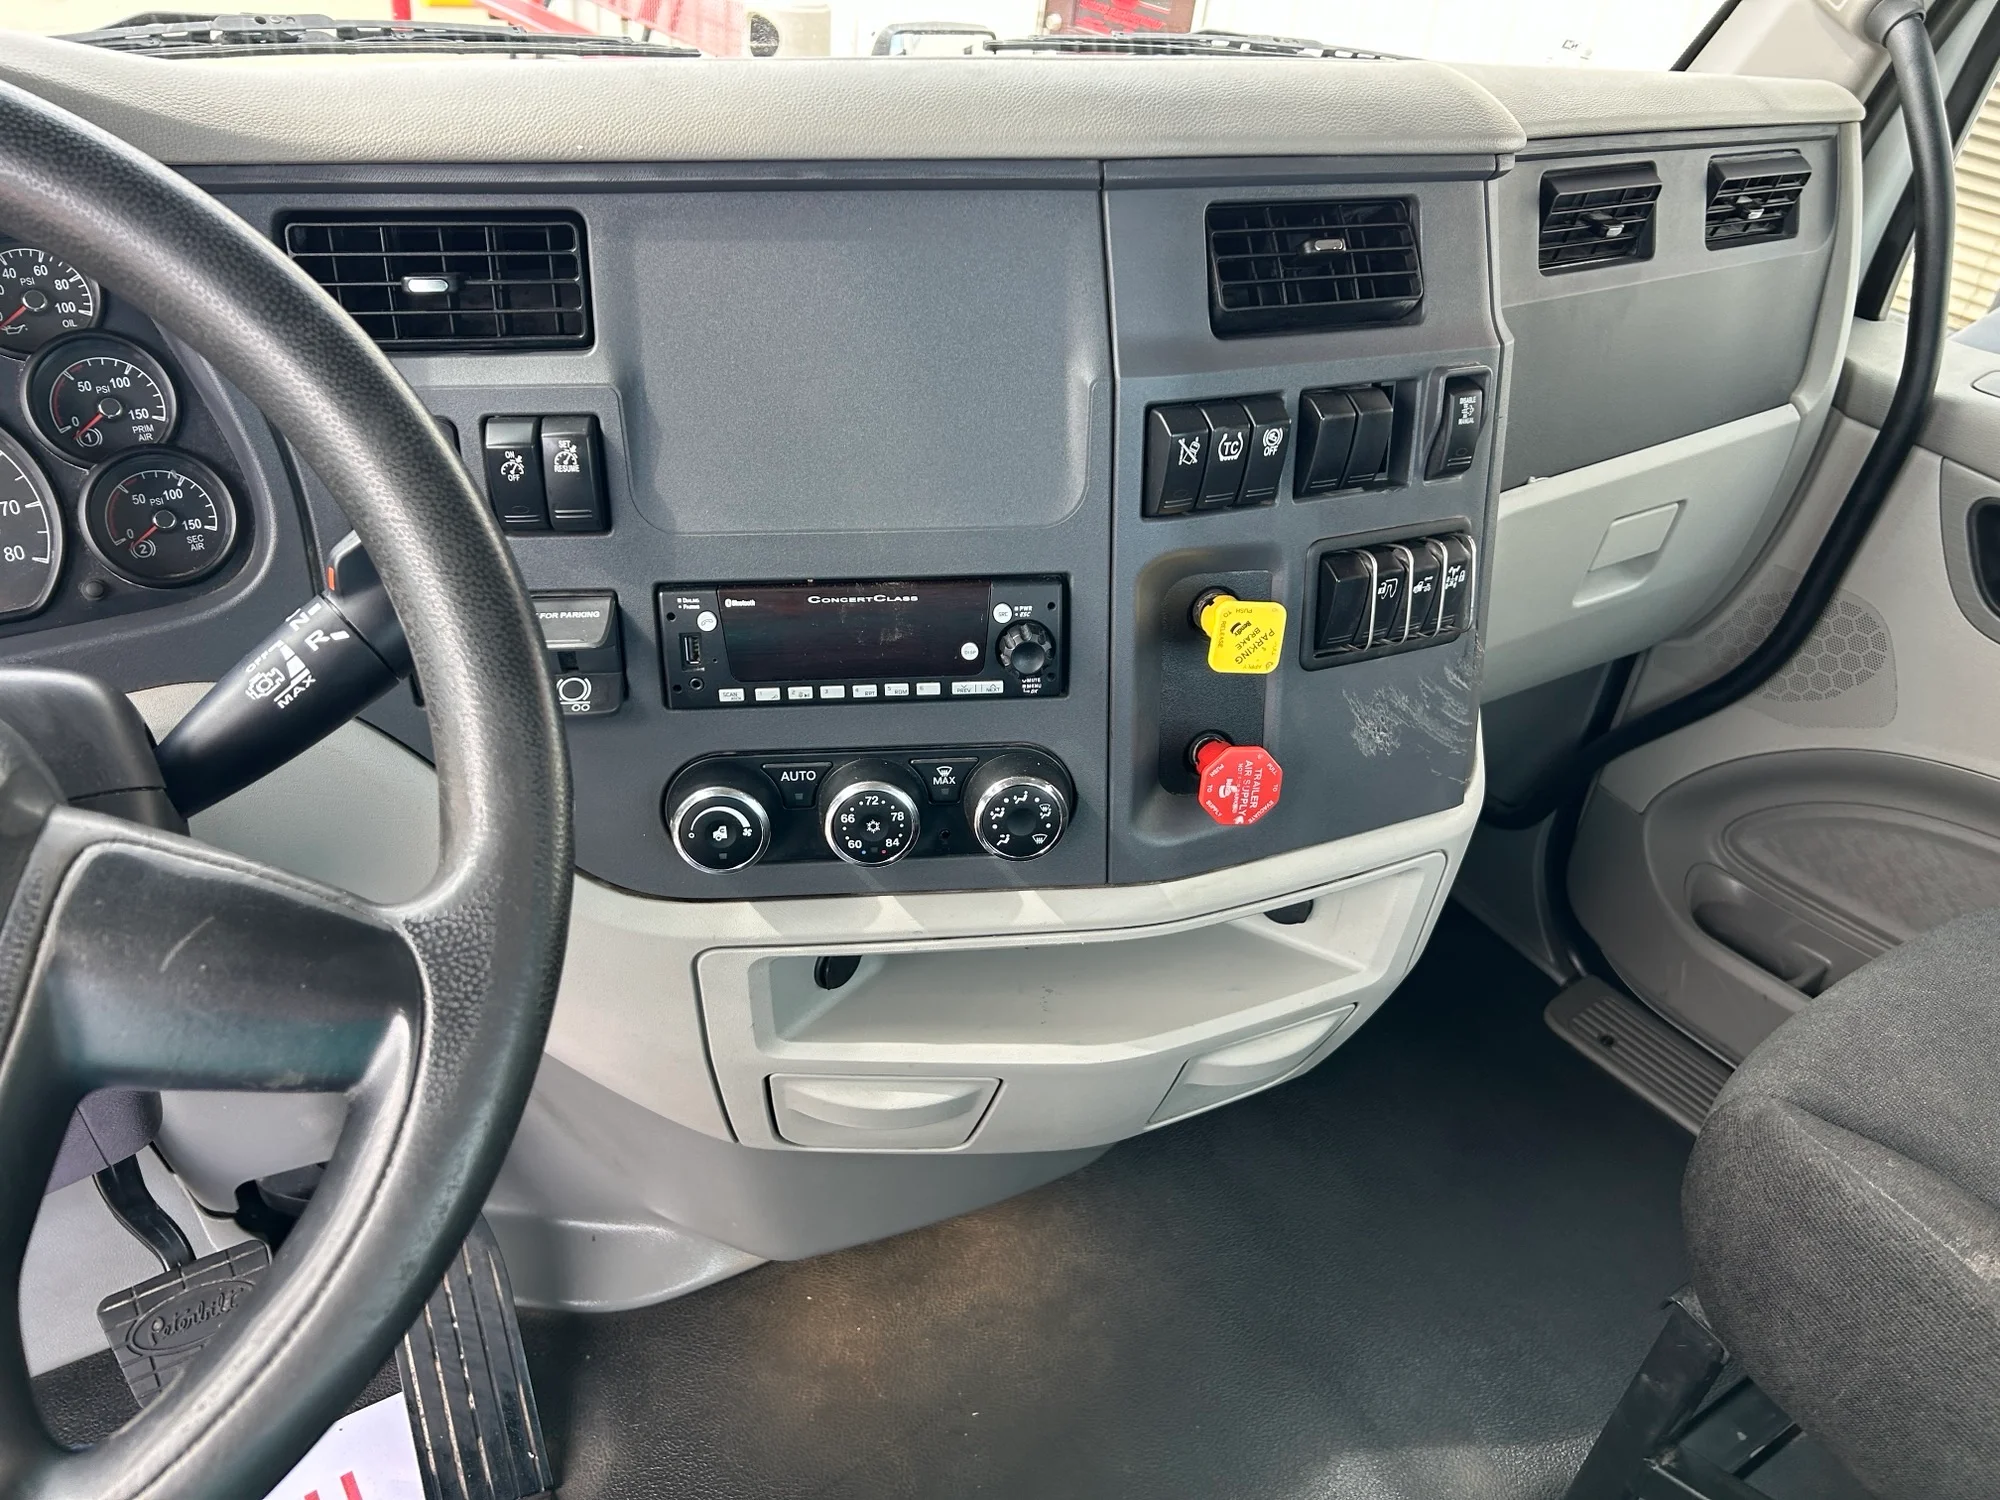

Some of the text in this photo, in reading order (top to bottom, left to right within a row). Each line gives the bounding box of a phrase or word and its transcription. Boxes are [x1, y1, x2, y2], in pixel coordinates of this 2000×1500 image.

[2, 268, 17, 279] 40
[33, 265, 48, 276] 60
[20, 277, 35, 286] PSI
[54, 279, 69, 290] 80
[55, 302, 76, 314] 100
[62, 319, 77, 328] OIL
[77, 380, 92, 392] 50
[110, 376, 130, 388] 100
[96, 386, 110, 394] PSI
[128, 408, 149, 420] 150
[132, 424, 154, 433] PRIM
[138, 433, 153, 442] AIR
[558, 440, 571, 448] SET
[1224, 441, 1240, 455] TC
[1264, 446, 1278, 456] OFF
[554, 464, 580, 472] RESUME
[132, 494, 146, 505] 50
[163, 489, 183, 501] 100
[150, 498, 164, 506] PSI
[0, 500, 20, 516] 70
[182, 518, 202, 530] 150
[186, 534, 204, 544] SEC
[190, 542, 205, 551] AIR
[4, 545, 25, 562] 80
[560, 610, 600, 618] PARKING
[289, 611, 310, 632] N
[304, 630, 330, 652] R
[1235, 627, 1261, 650] BRAKE
[1234, 628, 1275, 664] PARKING
[277, 674, 316, 708] MAX
[1244, 760, 1254, 776] AIR
[780, 770, 816, 782] AUTO
[933, 776, 956, 786] MAX
[1206, 763, 1224, 818] PUSH TO SUPPLY
[1250, 768, 1263, 808] TRAILER
[865, 796, 879, 806] 72
[1238, 780, 1252, 816] SUPPLY
[891, 812, 905, 822] 78
[1248, 800, 1274, 824] EVACUATE
[840, 814, 855, 824] 66
[848, 840, 862, 849] 60
[886, 838, 900, 848] 84
